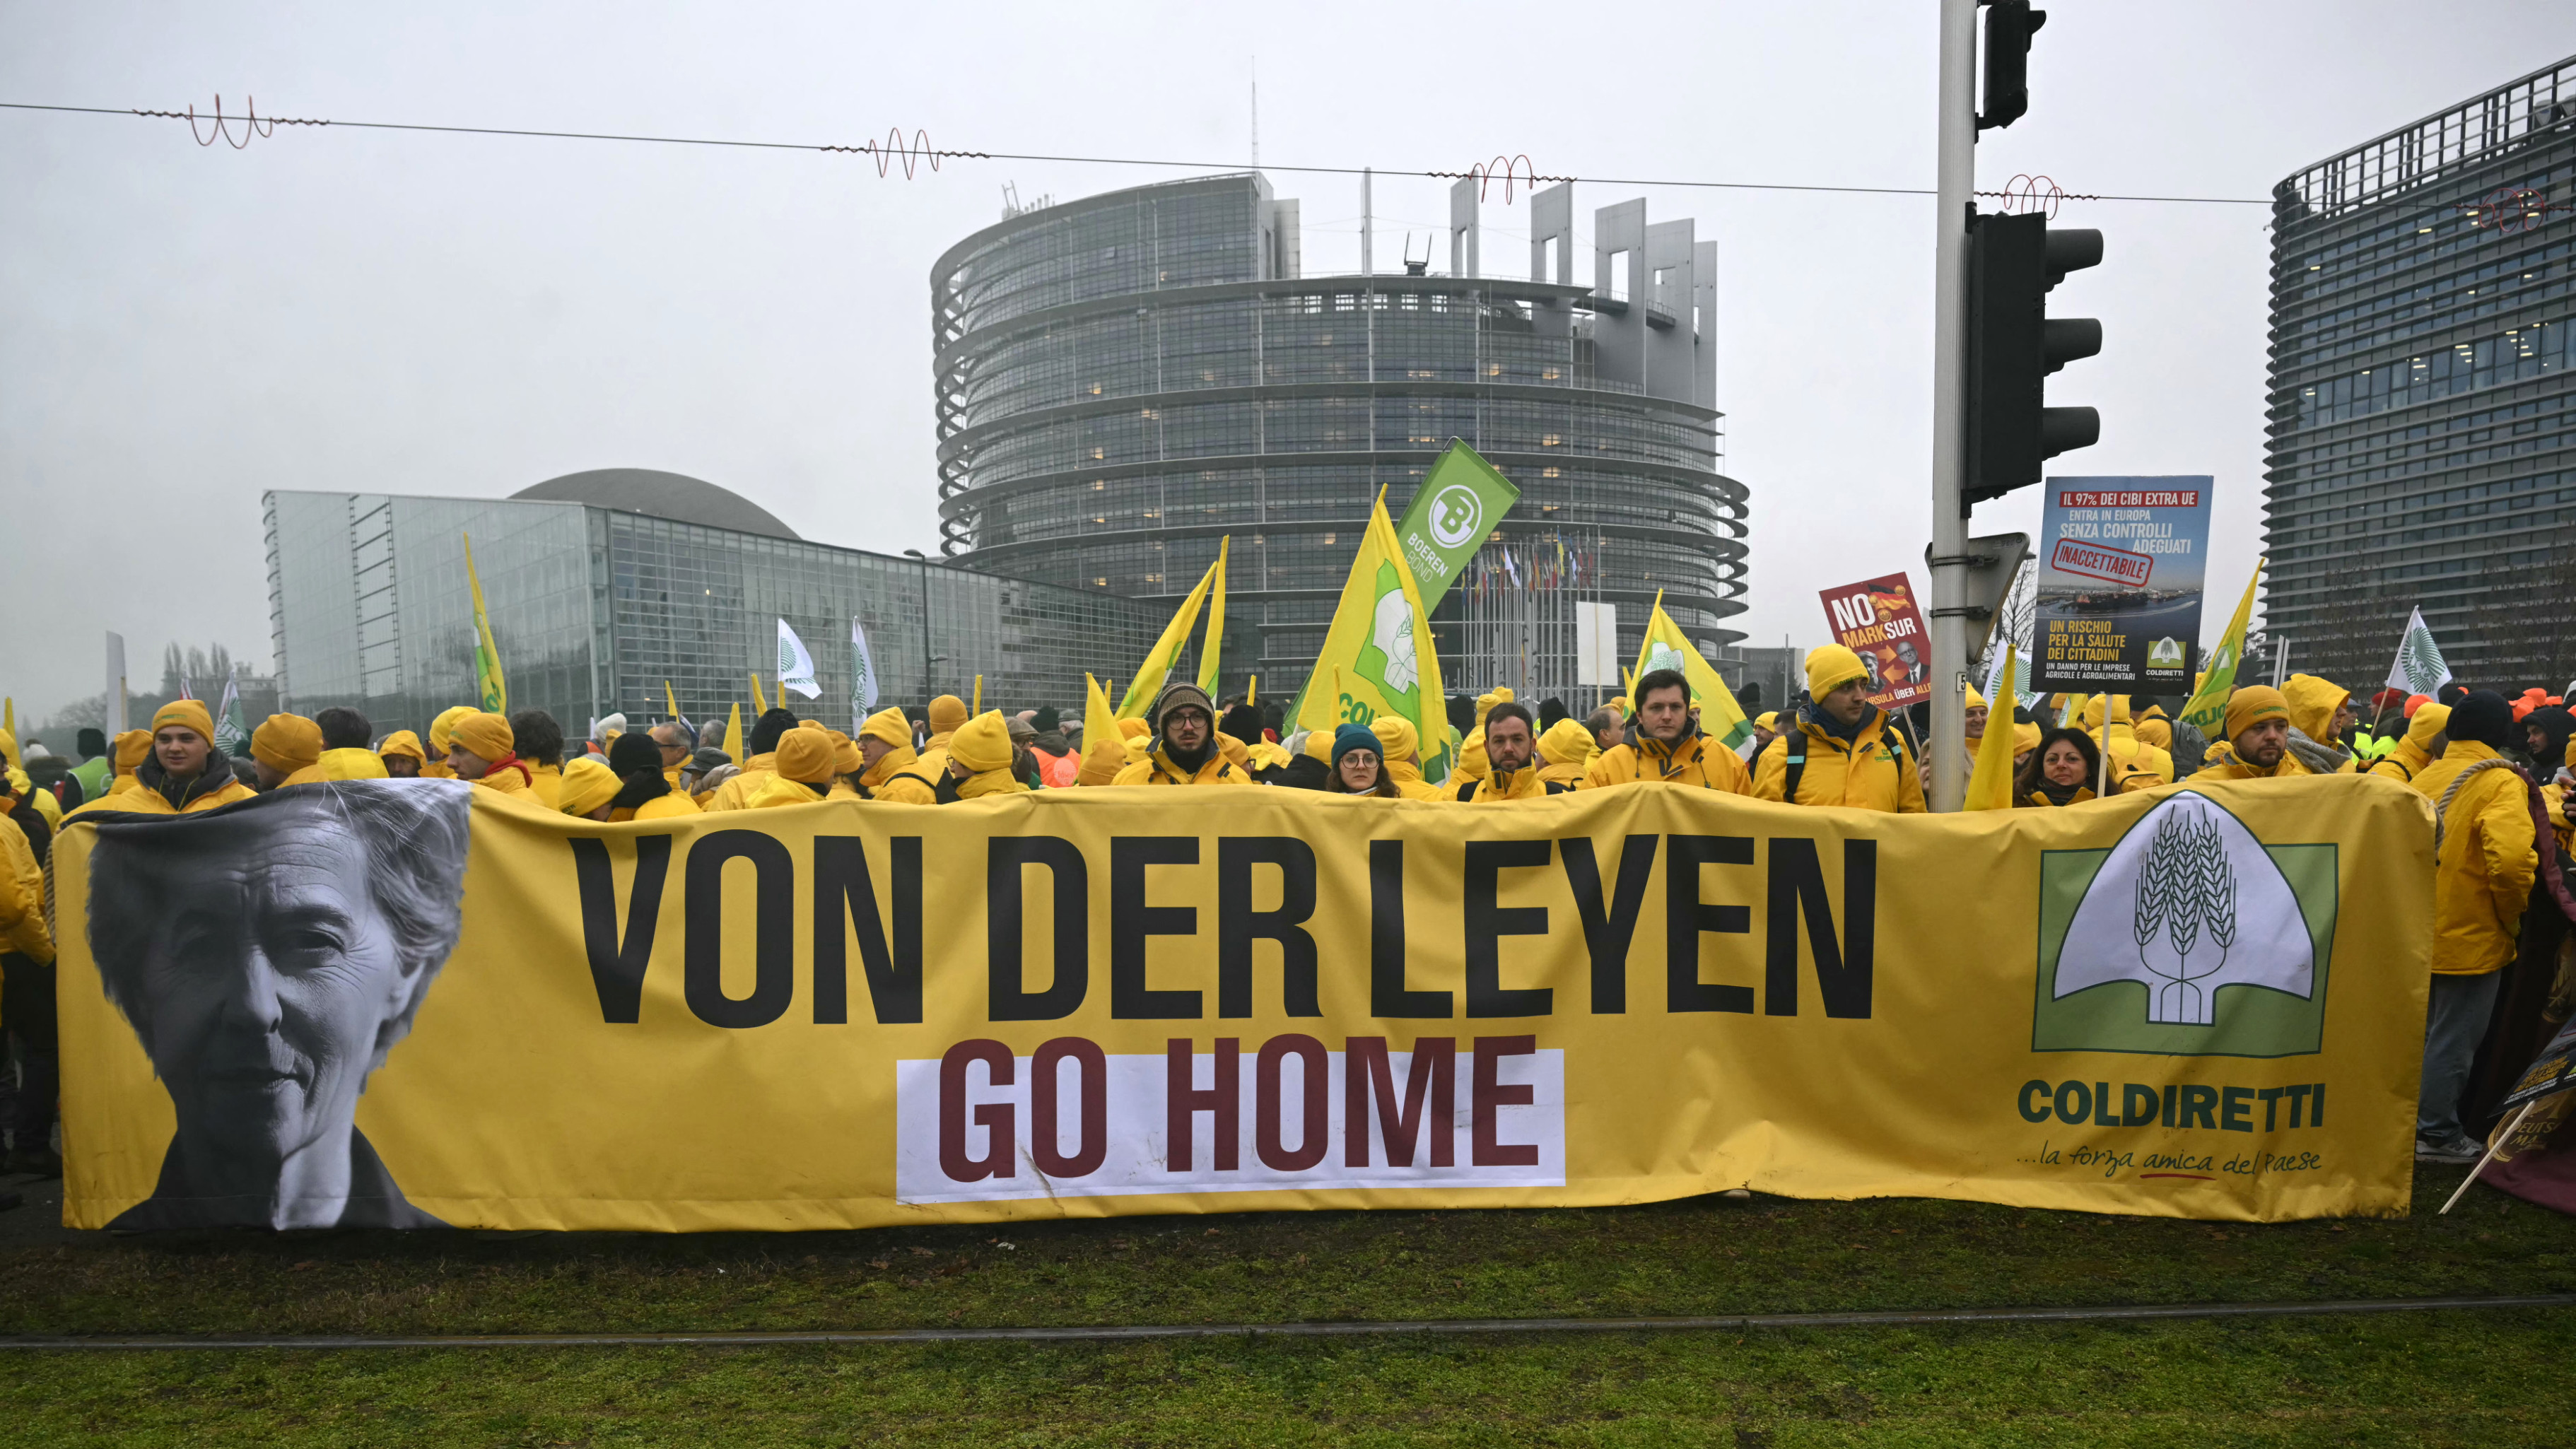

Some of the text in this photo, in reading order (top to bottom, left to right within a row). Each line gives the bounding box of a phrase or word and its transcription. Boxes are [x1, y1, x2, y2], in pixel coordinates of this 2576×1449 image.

[2063, 492, 2195, 505] IL 97% DEI CIBI EXTRA UE
[2069, 510, 2150, 521] ENTRA IN EUROPA
[2059, 523, 2172, 539] SENZA CONTROLLI
[1407, 532, 1448, 577] BOEREN
[2132, 539, 2191, 553] ADEGUATI
[1405, 551, 1433, 582] BOND
[2059, 545, 2146, 580] INACCETTABILE
[1831, 593, 1875, 631] NO
[1842, 617, 1917, 649] MARKSUR
[2050, 620, 2112, 633] UN RISCHIO
[2049, 634, 2126, 647] PER LA SALUTE
[2047, 647, 2119, 661] DEI CITTADINI
[1961, 674, 1966, 691] 5
[2082, 671, 2136, 681] AGROALIMENTARI
[1894, 687, 1916, 700] ÜBER
[569, 829, 1877, 1029] VON DER LEYEN
[939, 1033, 1538, 1183] GO HOME
[2018, 1079, 2326, 1132] COLDIRETTI
[2069, 1144, 2134, 1178] forza
[2143, 1149, 2214, 1171] amica
[2223, 1151, 2261, 1175] del
[2264, 1151, 2322, 1174] Paese
